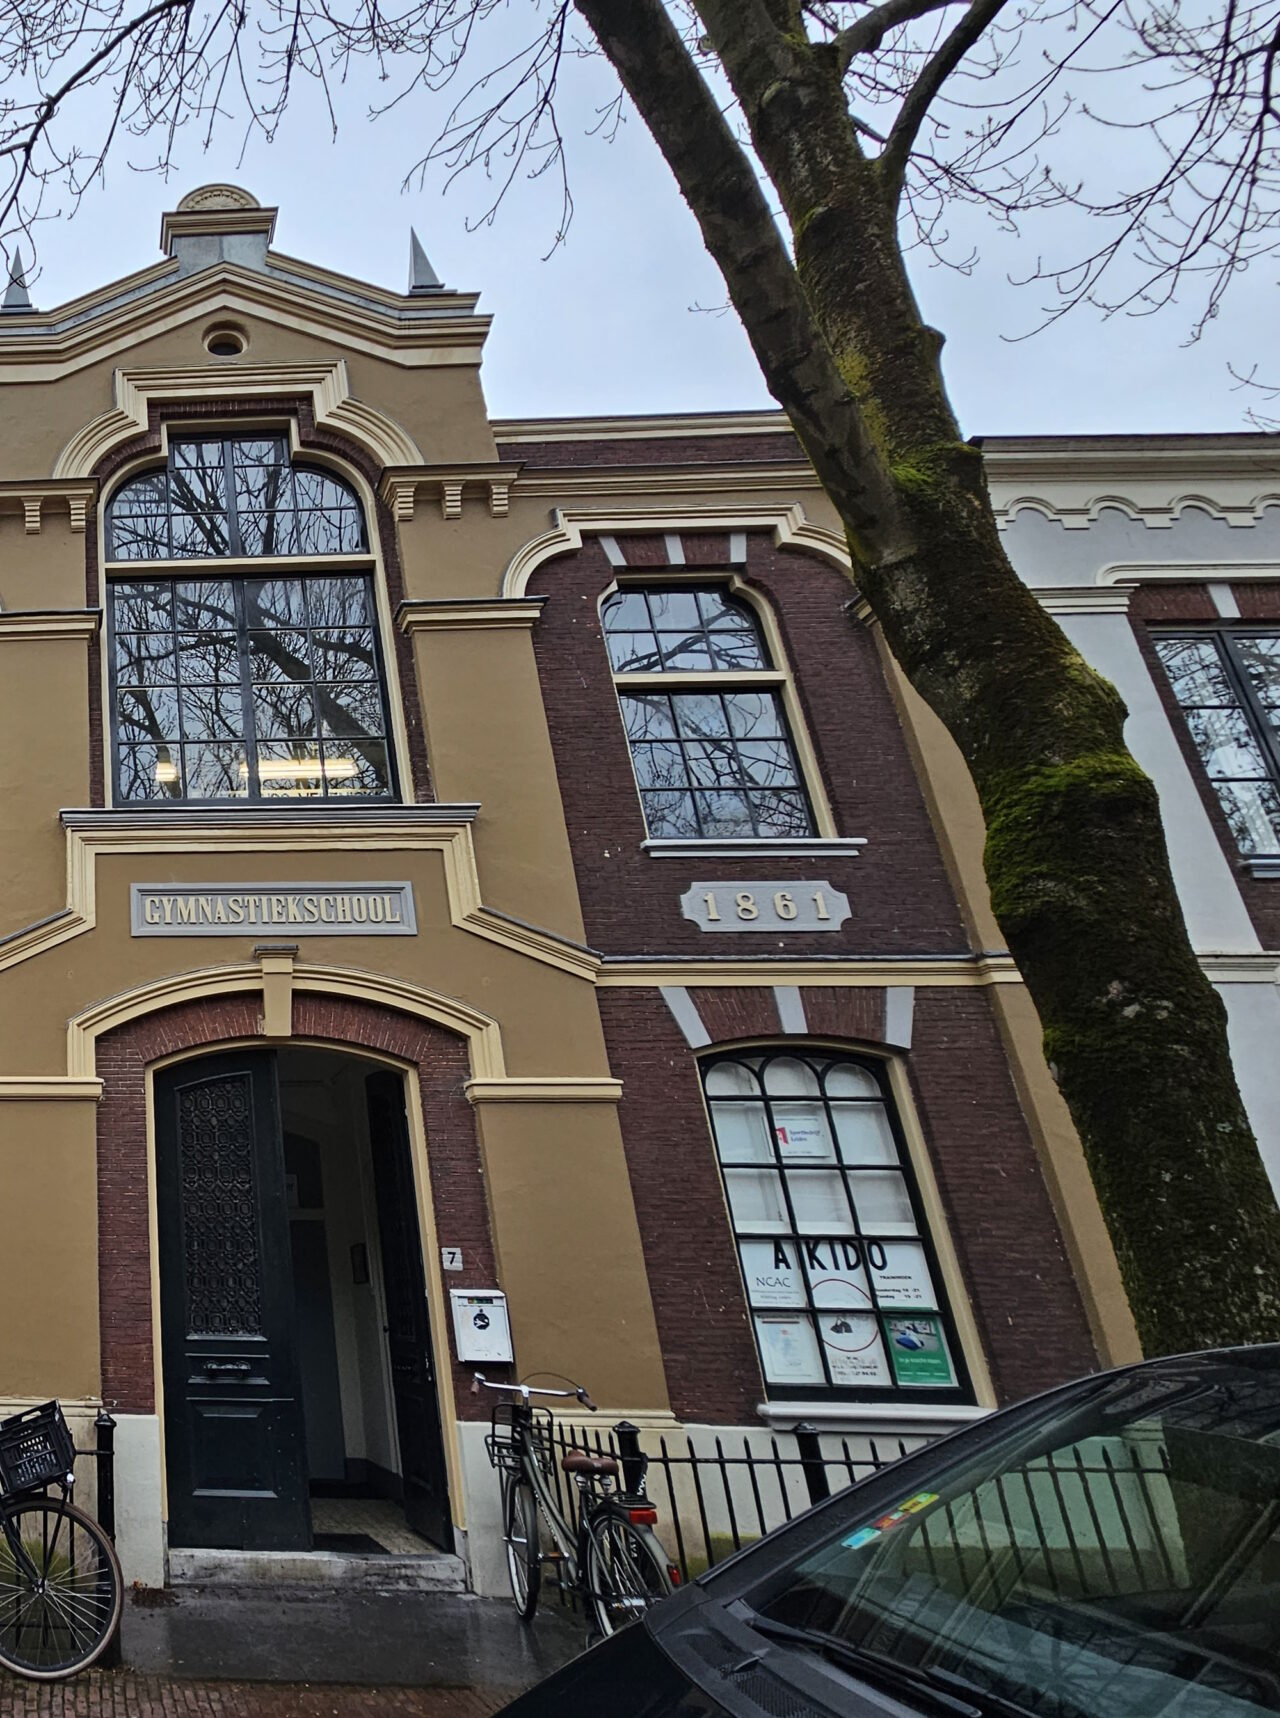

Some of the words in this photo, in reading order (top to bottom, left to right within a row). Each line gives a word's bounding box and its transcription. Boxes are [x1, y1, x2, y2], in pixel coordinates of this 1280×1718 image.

[144, 895, 401, 925] GYMNASTIEKSCHOOL
[703, 891, 831, 921] 1861
[447, 1251, 456, 1265] 7
[773, 1239, 888, 1271] AKIDO
[756, 1277, 791, 1288] NCAC
